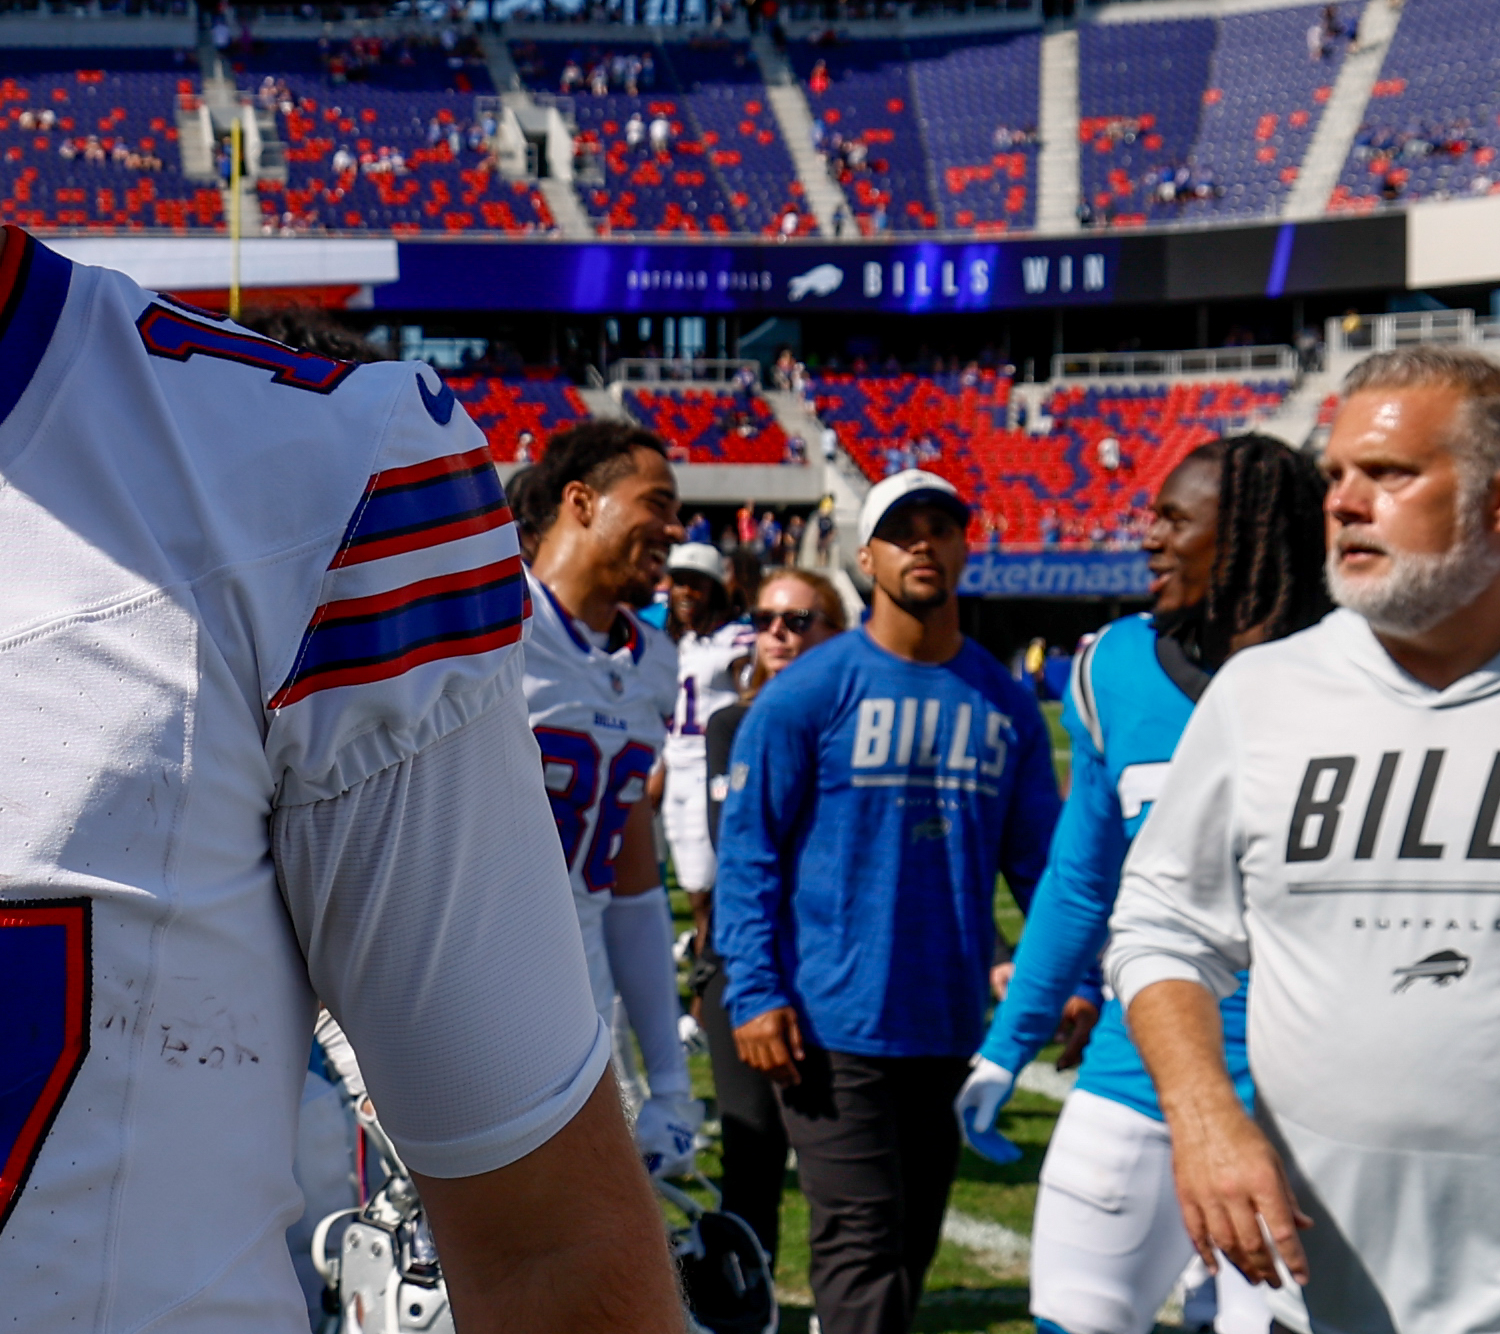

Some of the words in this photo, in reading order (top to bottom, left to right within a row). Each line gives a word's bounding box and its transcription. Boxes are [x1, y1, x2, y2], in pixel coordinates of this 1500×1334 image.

[862, 260, 990, 299] BILLS
[1022, 254, 1106, 295] WIN
[852, 697, 1012, 777] BILLS
